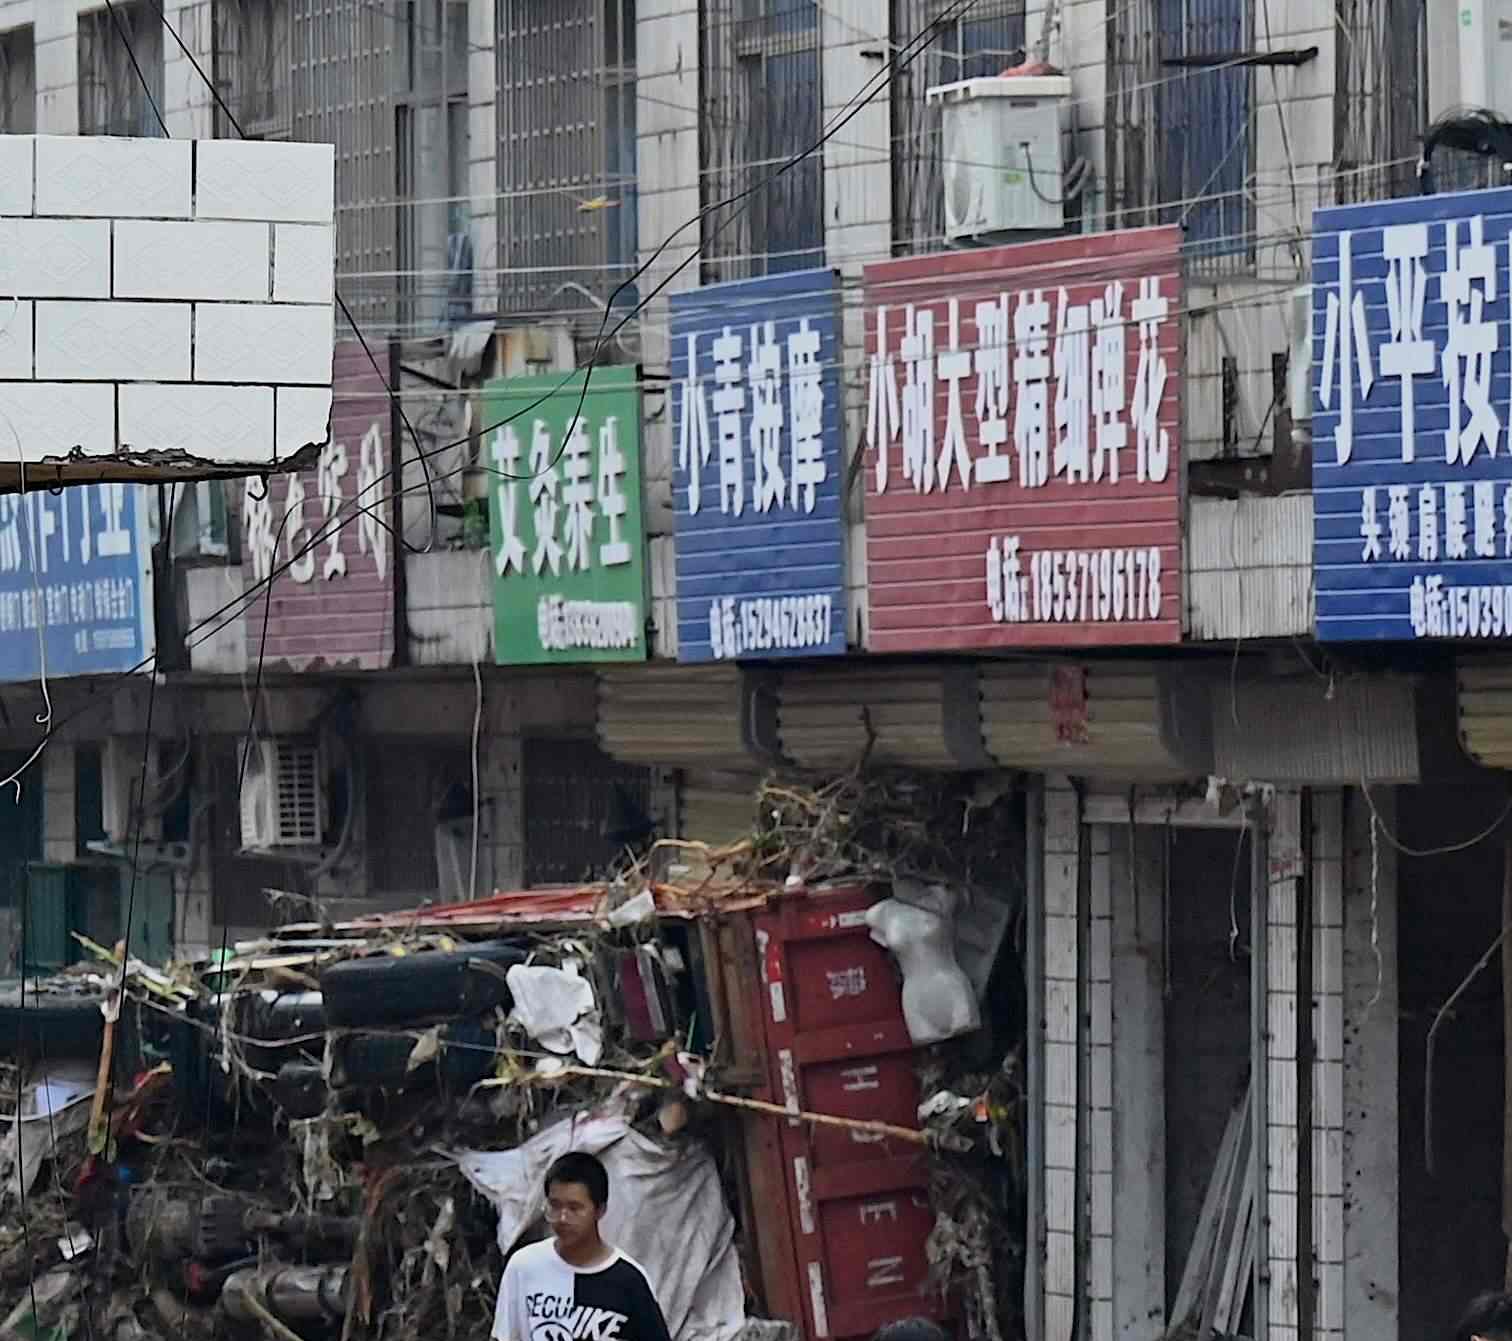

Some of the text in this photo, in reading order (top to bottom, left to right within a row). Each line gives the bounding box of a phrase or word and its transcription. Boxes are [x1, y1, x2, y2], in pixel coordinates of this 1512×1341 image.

[680, 316, 827, 518] 小青按摩
[866, 276, 1170, 495] 小胡大型精细弹花
[491, 416, 632, 577] 艾灸养生
[986, 535, 1162, 622] 电话:18537196178
